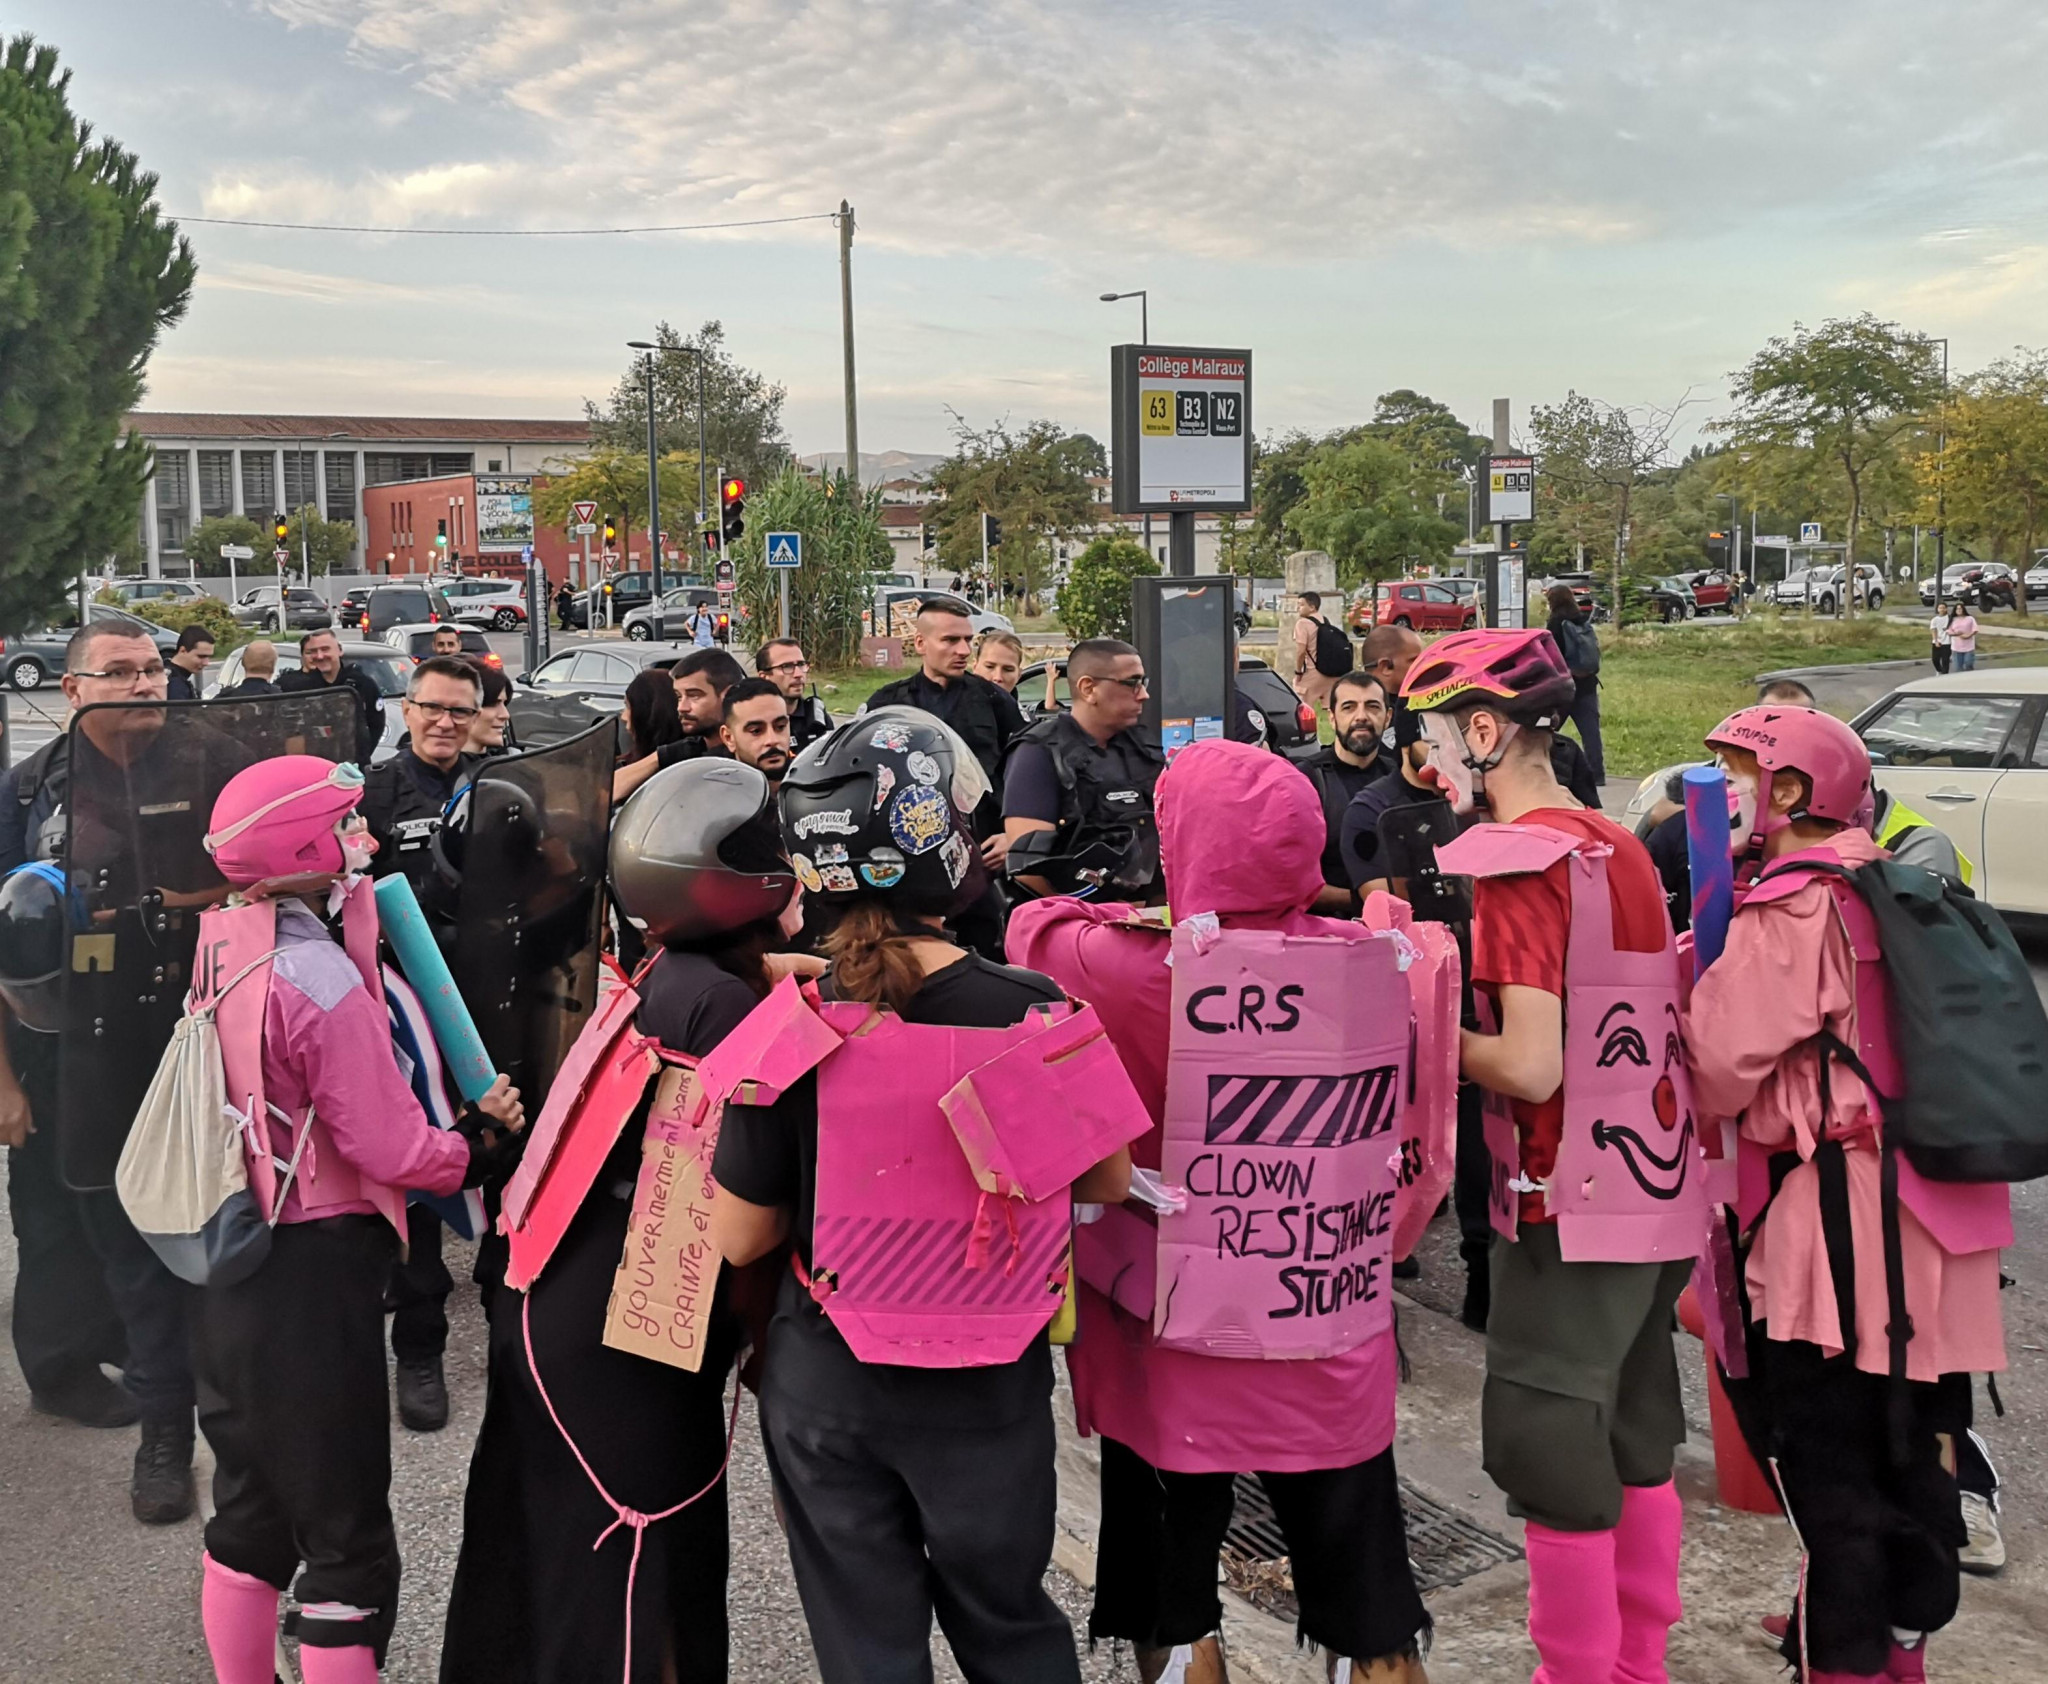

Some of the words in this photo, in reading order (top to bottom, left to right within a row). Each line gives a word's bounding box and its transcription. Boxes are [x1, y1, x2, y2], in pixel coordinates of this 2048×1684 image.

[1138, 356, 1189, 378] Collège
[1192, 358, 1245, 376] Malraux
[1150, 397, 1166, 419] 63
[1184, 398, 1201, 420] B3
[1217, 398, 1235, 420] N2
[1186, 1152, 1315, 1200] CLOWN
